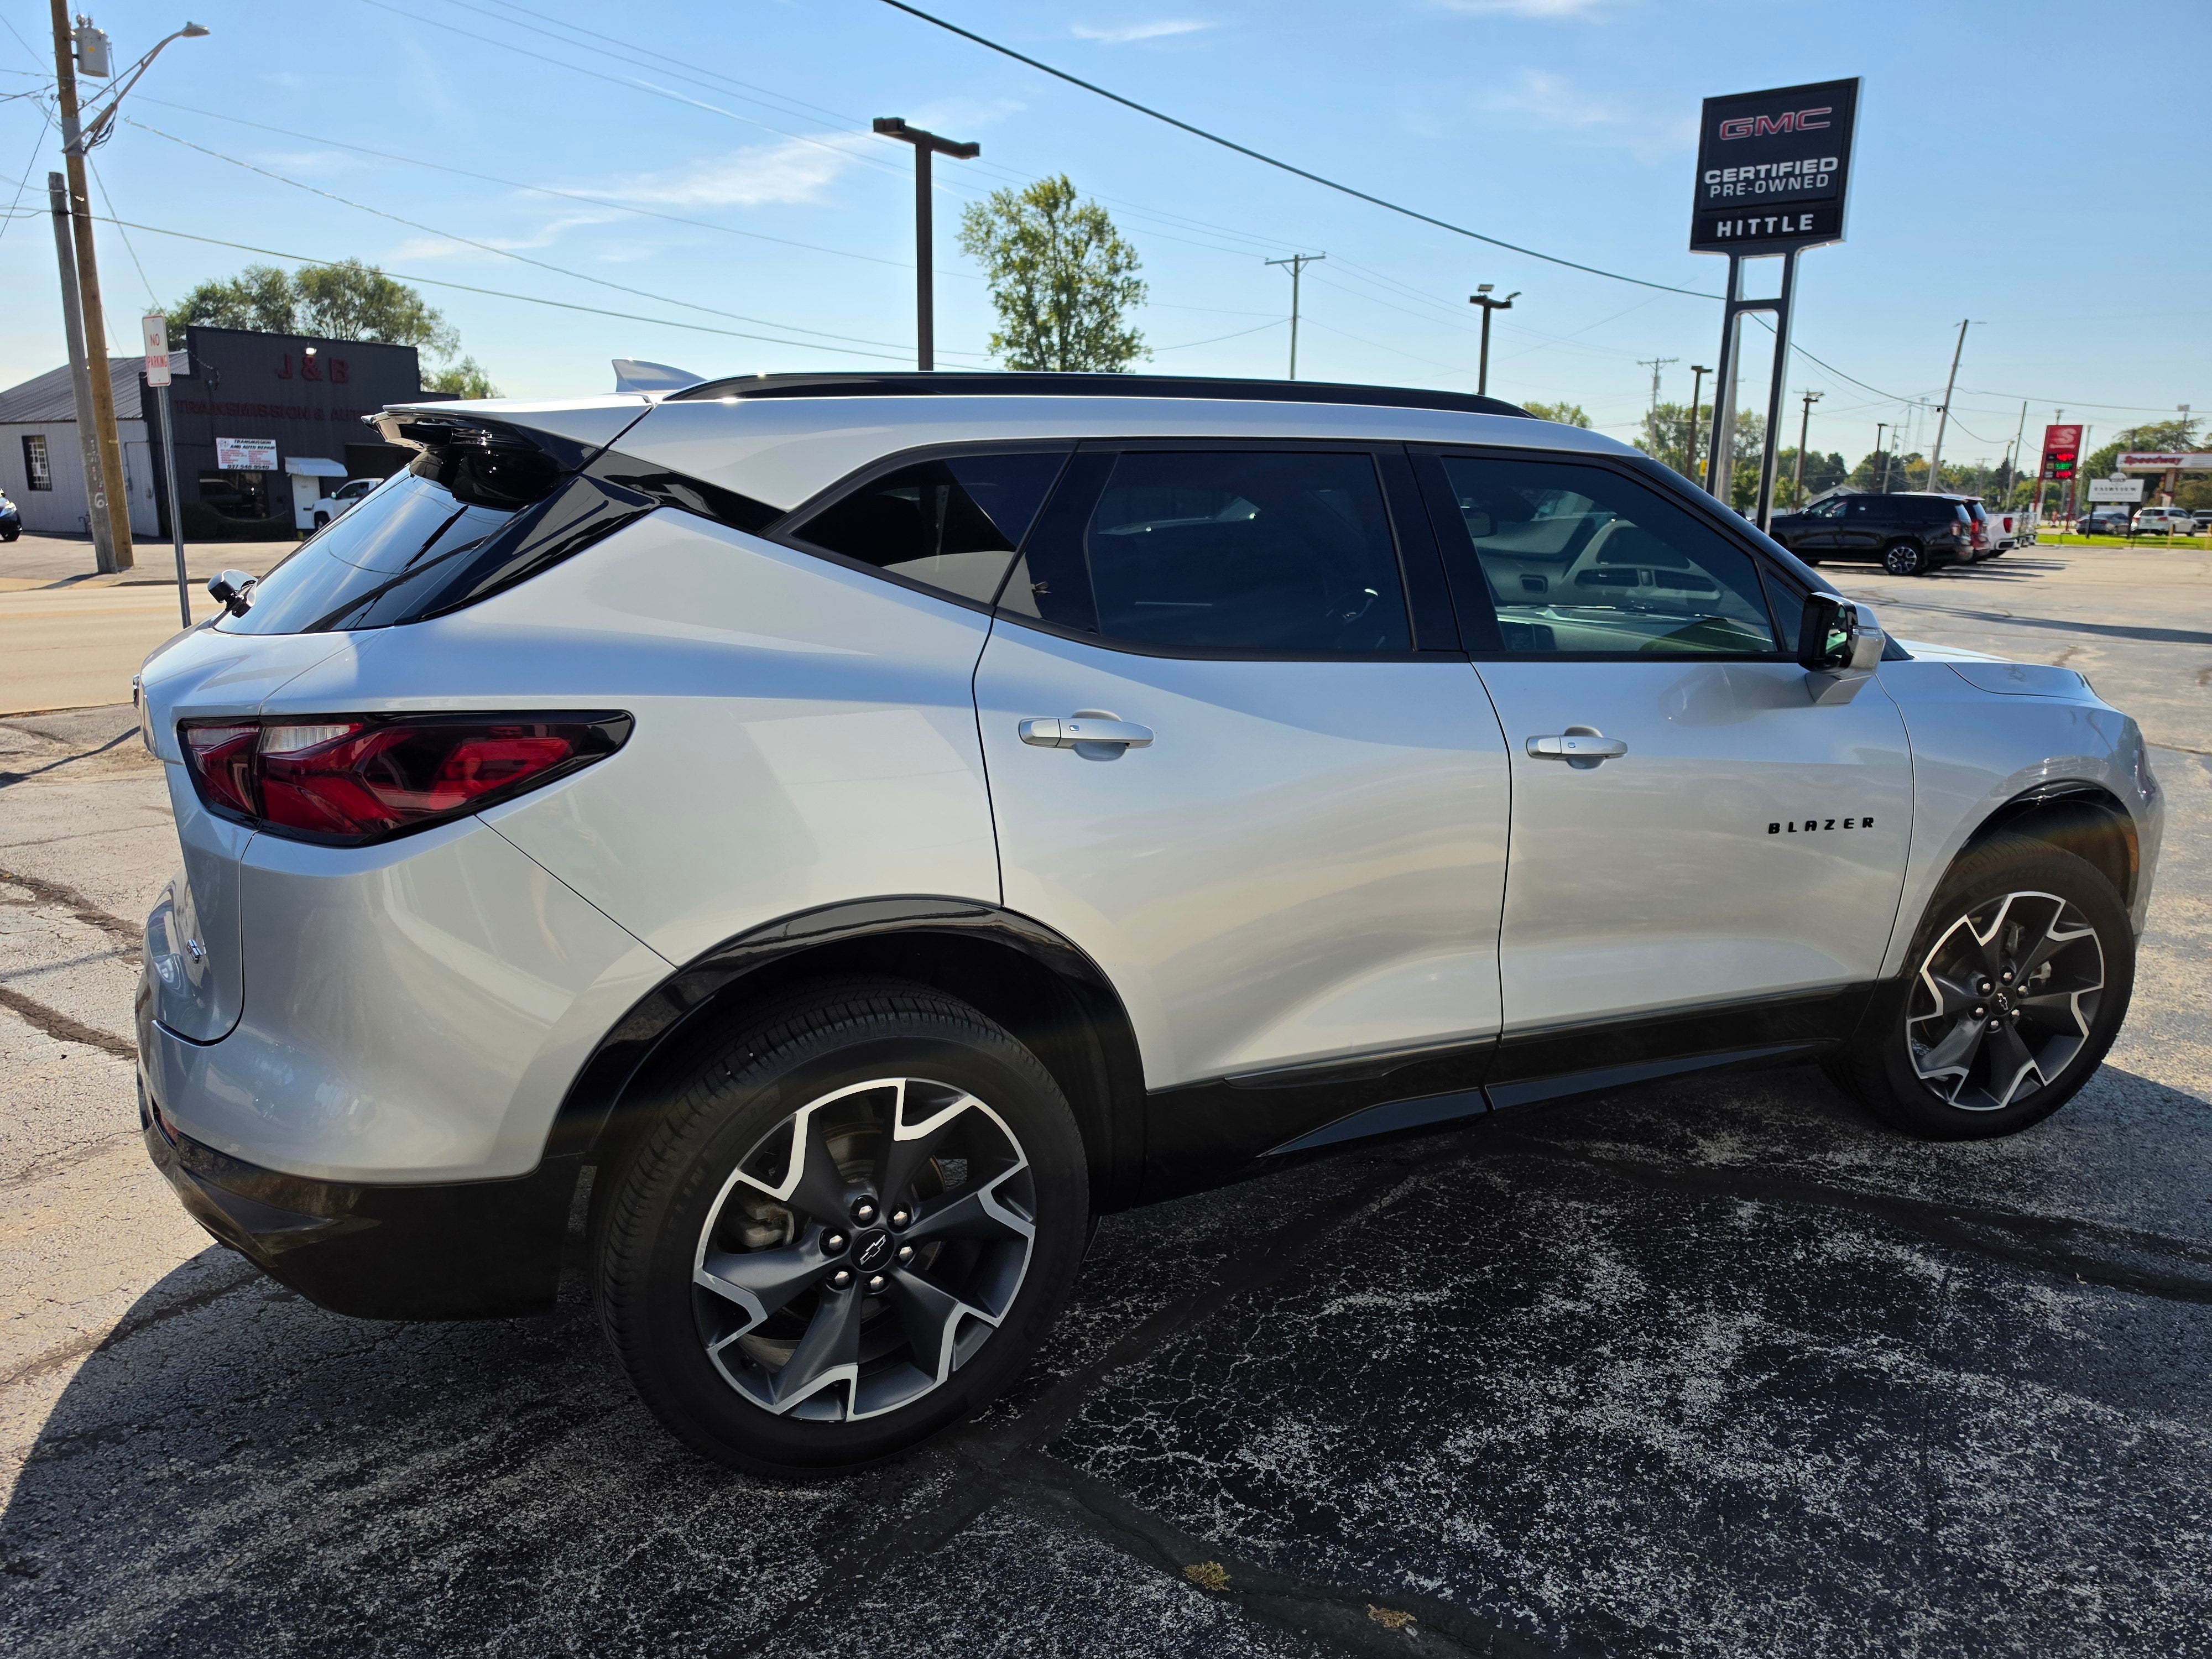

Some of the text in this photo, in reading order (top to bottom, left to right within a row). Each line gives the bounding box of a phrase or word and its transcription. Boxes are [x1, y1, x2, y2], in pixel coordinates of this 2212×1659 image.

[1719, 107, 1832, 140] GMC
[1704, 157, 1839, 184] CERTIFIED
[1710, 174, 1829, 198] PRE-OWNED
[1717, 214, 1814, 238] HITTLE
[150, 333, 160, 346] NO
[147, 355, 168, 368] PARKING
[277, 353, 349, 383] J & B
[174, 400, 311, 420] TRANSMISSION
[2124, 455, 2184, 466] Speedway
[1768, 817, 1874, 834] BLAZER
